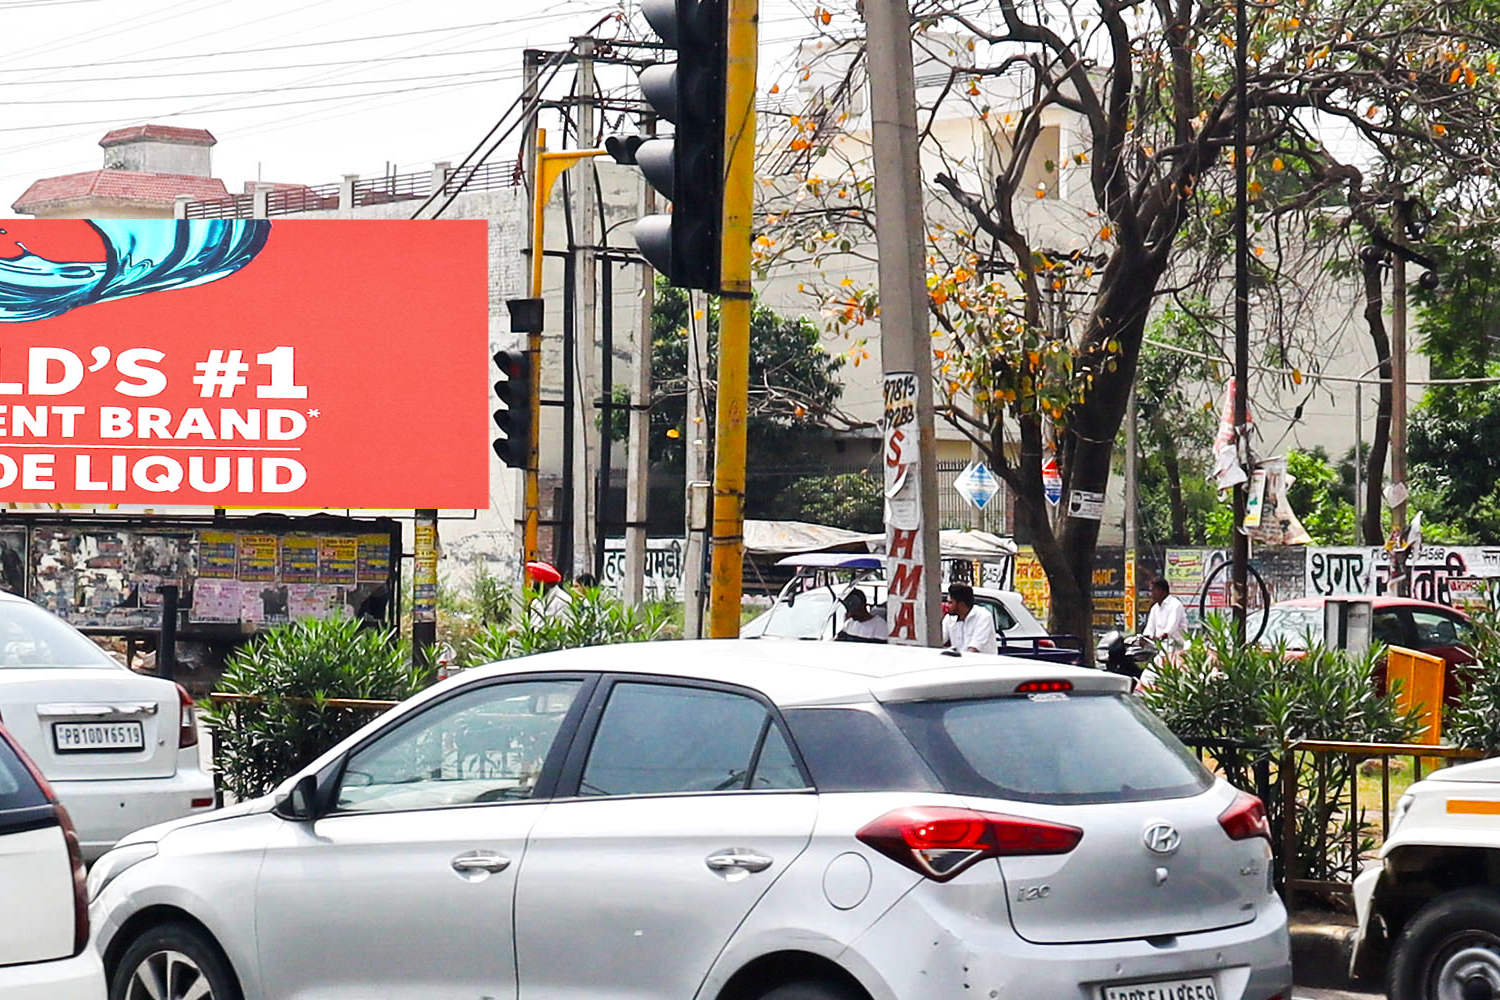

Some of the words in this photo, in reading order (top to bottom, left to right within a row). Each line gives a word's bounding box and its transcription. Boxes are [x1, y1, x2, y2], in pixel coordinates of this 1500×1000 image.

[193, 346, 308, 399] #1
[75, 454, 308, 493] LIQUID
[65, 727, 140, 744] PB10DY6519
